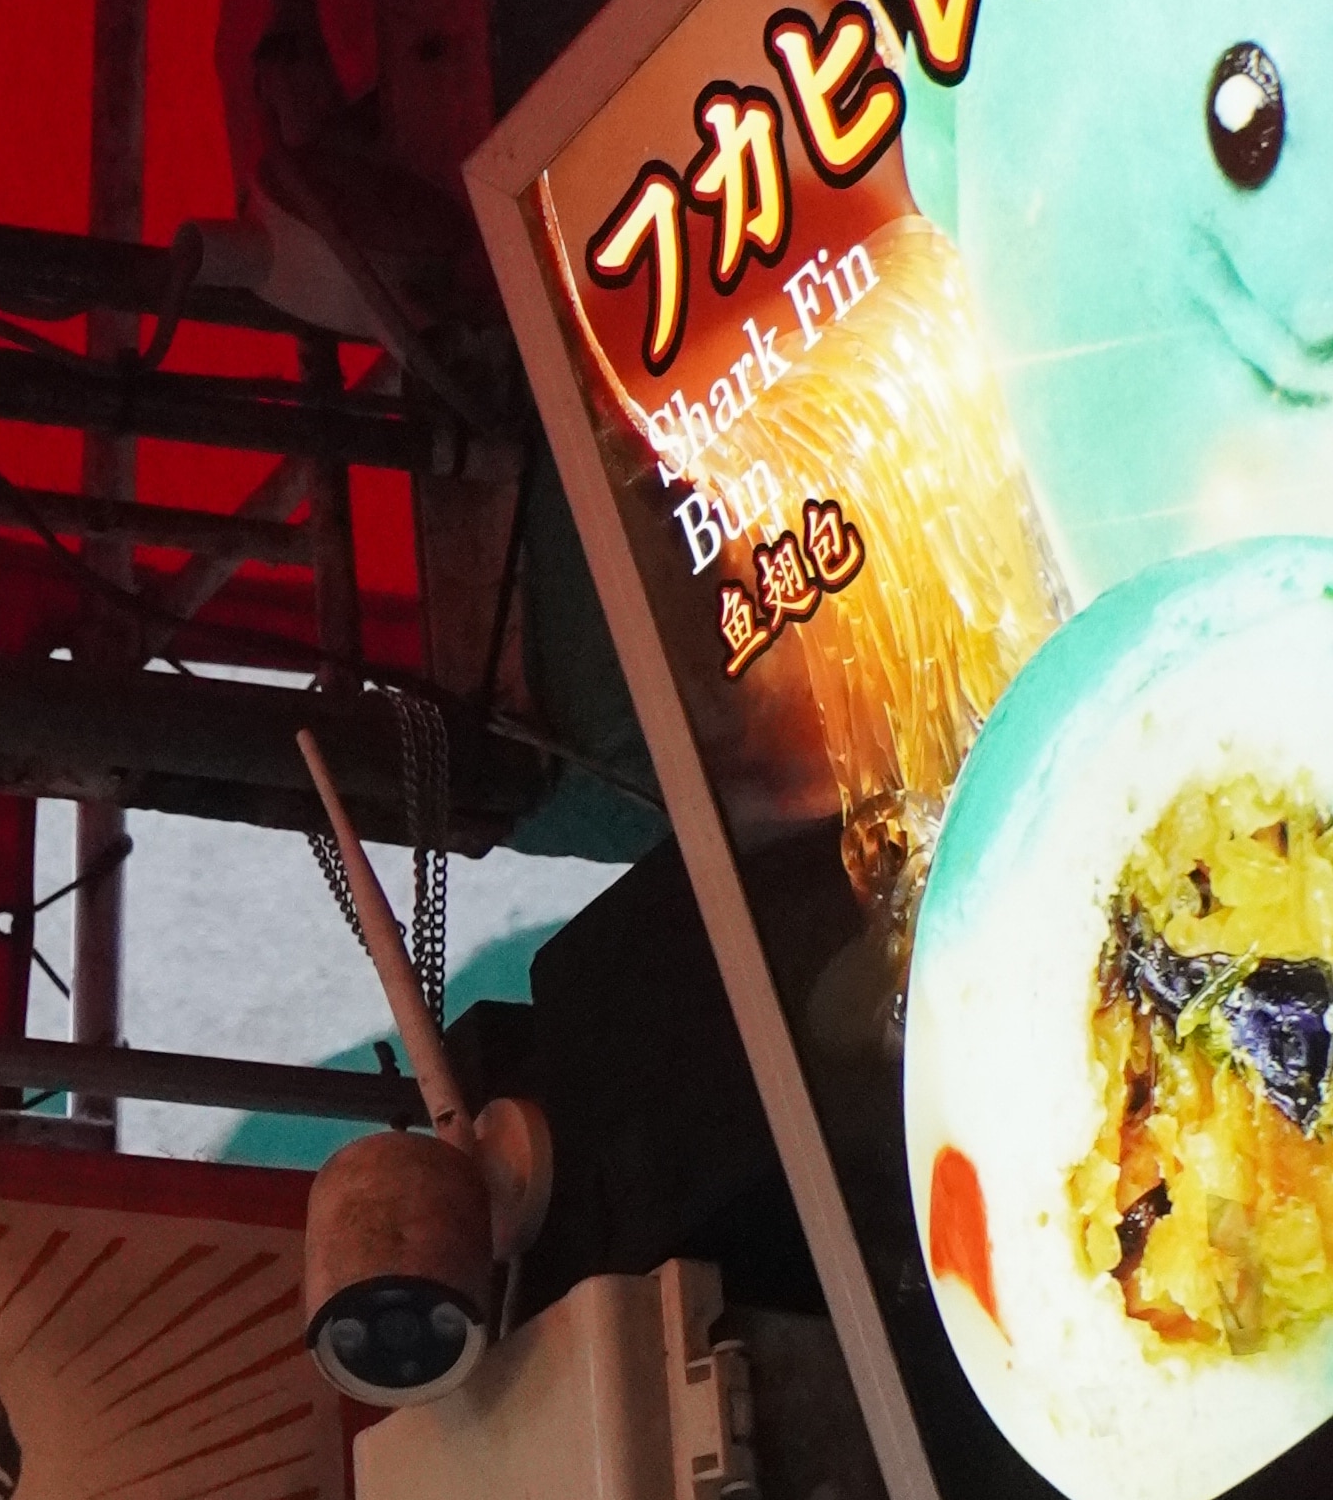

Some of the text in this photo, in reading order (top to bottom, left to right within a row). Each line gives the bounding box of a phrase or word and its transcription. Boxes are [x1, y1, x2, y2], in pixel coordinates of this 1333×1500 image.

[648, 241, 880, 488] Shark Fin
[673, 458, 782, 576] Bun
[720, 501, 861, 675] 鱼翅包
